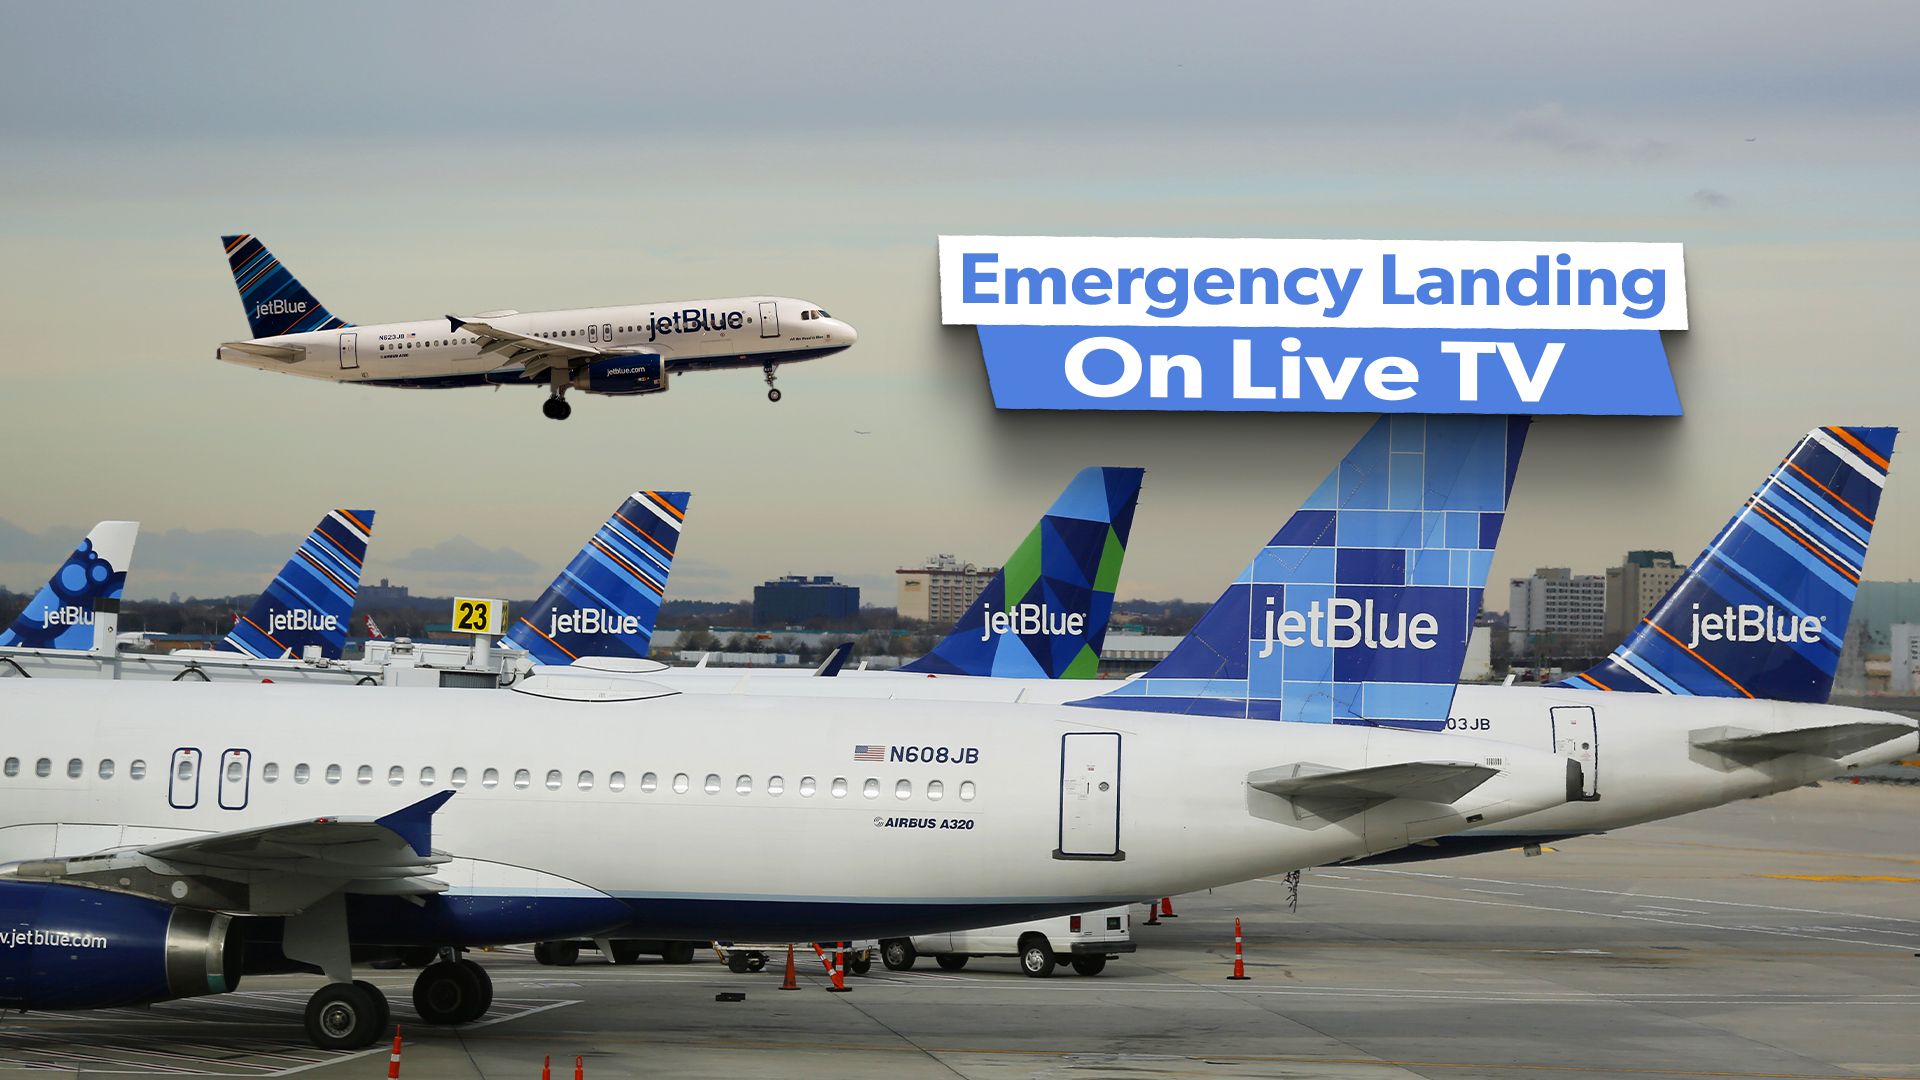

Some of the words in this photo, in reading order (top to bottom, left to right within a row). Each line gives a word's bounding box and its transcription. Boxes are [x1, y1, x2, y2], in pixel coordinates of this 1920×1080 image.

[256, 299, 307, 319] jetBlue
[649, 308, 744, 342] jetBlue
[607, 366, 646, 377] jetblue.com
[42, 605, 95, 629] jetBlu
[267, 607, 338, 635] jetBlue
[459, 602, 488, 630] 23
[548, 607, 639, 638] jetBlue
[981, 602, 1085, 642] jetBlue
[1259, 596, 1439, 659] jetBlue
[1687, 602, 1823, 649] jetBlue
[1447, 717, 1491, 731] 03JB
[889, 745, 980, 764] N608JB
[885, 817, 937, 829] AIRBUS
[939, 819, 975, 830] A320
